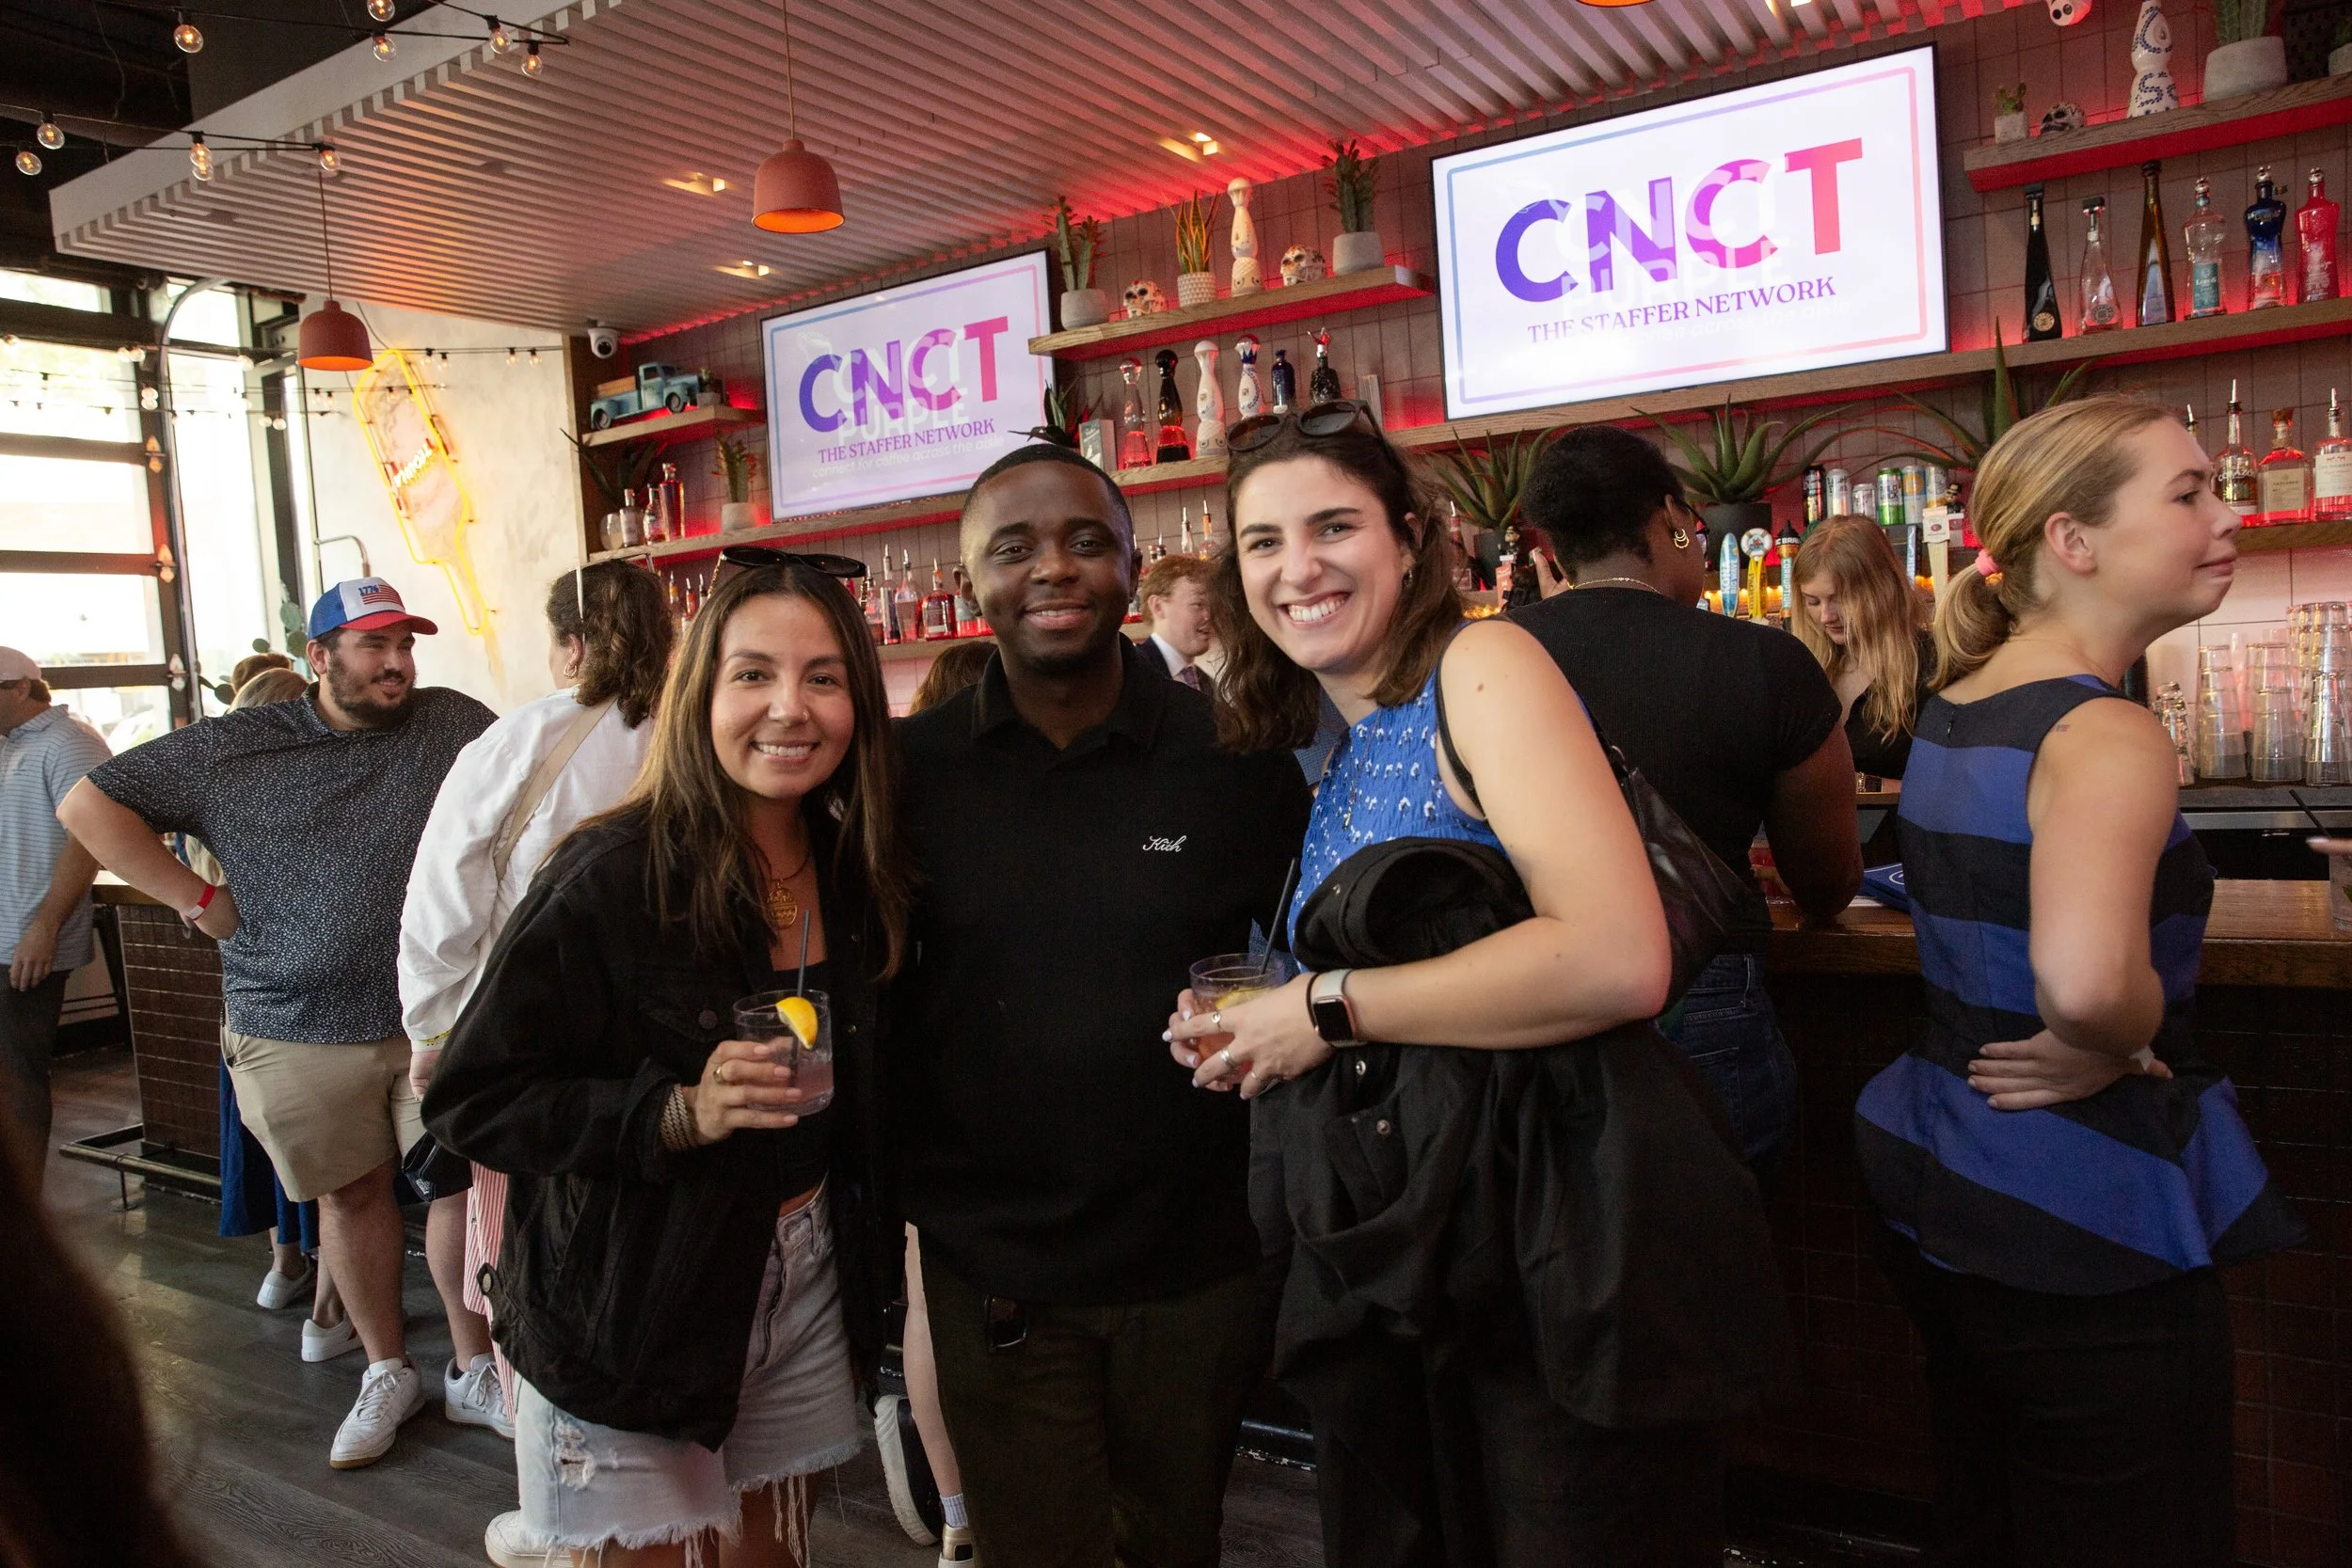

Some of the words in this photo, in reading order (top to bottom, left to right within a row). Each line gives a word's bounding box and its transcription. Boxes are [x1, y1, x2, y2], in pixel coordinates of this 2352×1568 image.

[1496, 137, 1863, 303] CNCT
[1527, 320, 1576, 343] THE
[1581, 301, 1690, 334] STAFFER
[1694, 277, 1836, 318] NETWORK
[799, 315, 1009, 433] CNCT
[837, 388, 969, 445] PURPLE
[818, 446, 847, 464] THE
[849, 434, 913, 458] STAFFER
[914, 419, 995, 446] NETWORK
[912, 445, 950, 461] across
[952, 439, 973, 453] the
[358, 585, 380, 595] 1776
[1721, 560, 1730, 594] KONA
[1783, 559, 1791, 608] CORRUPTION
[1142, 834, 1187, 853] Kith
